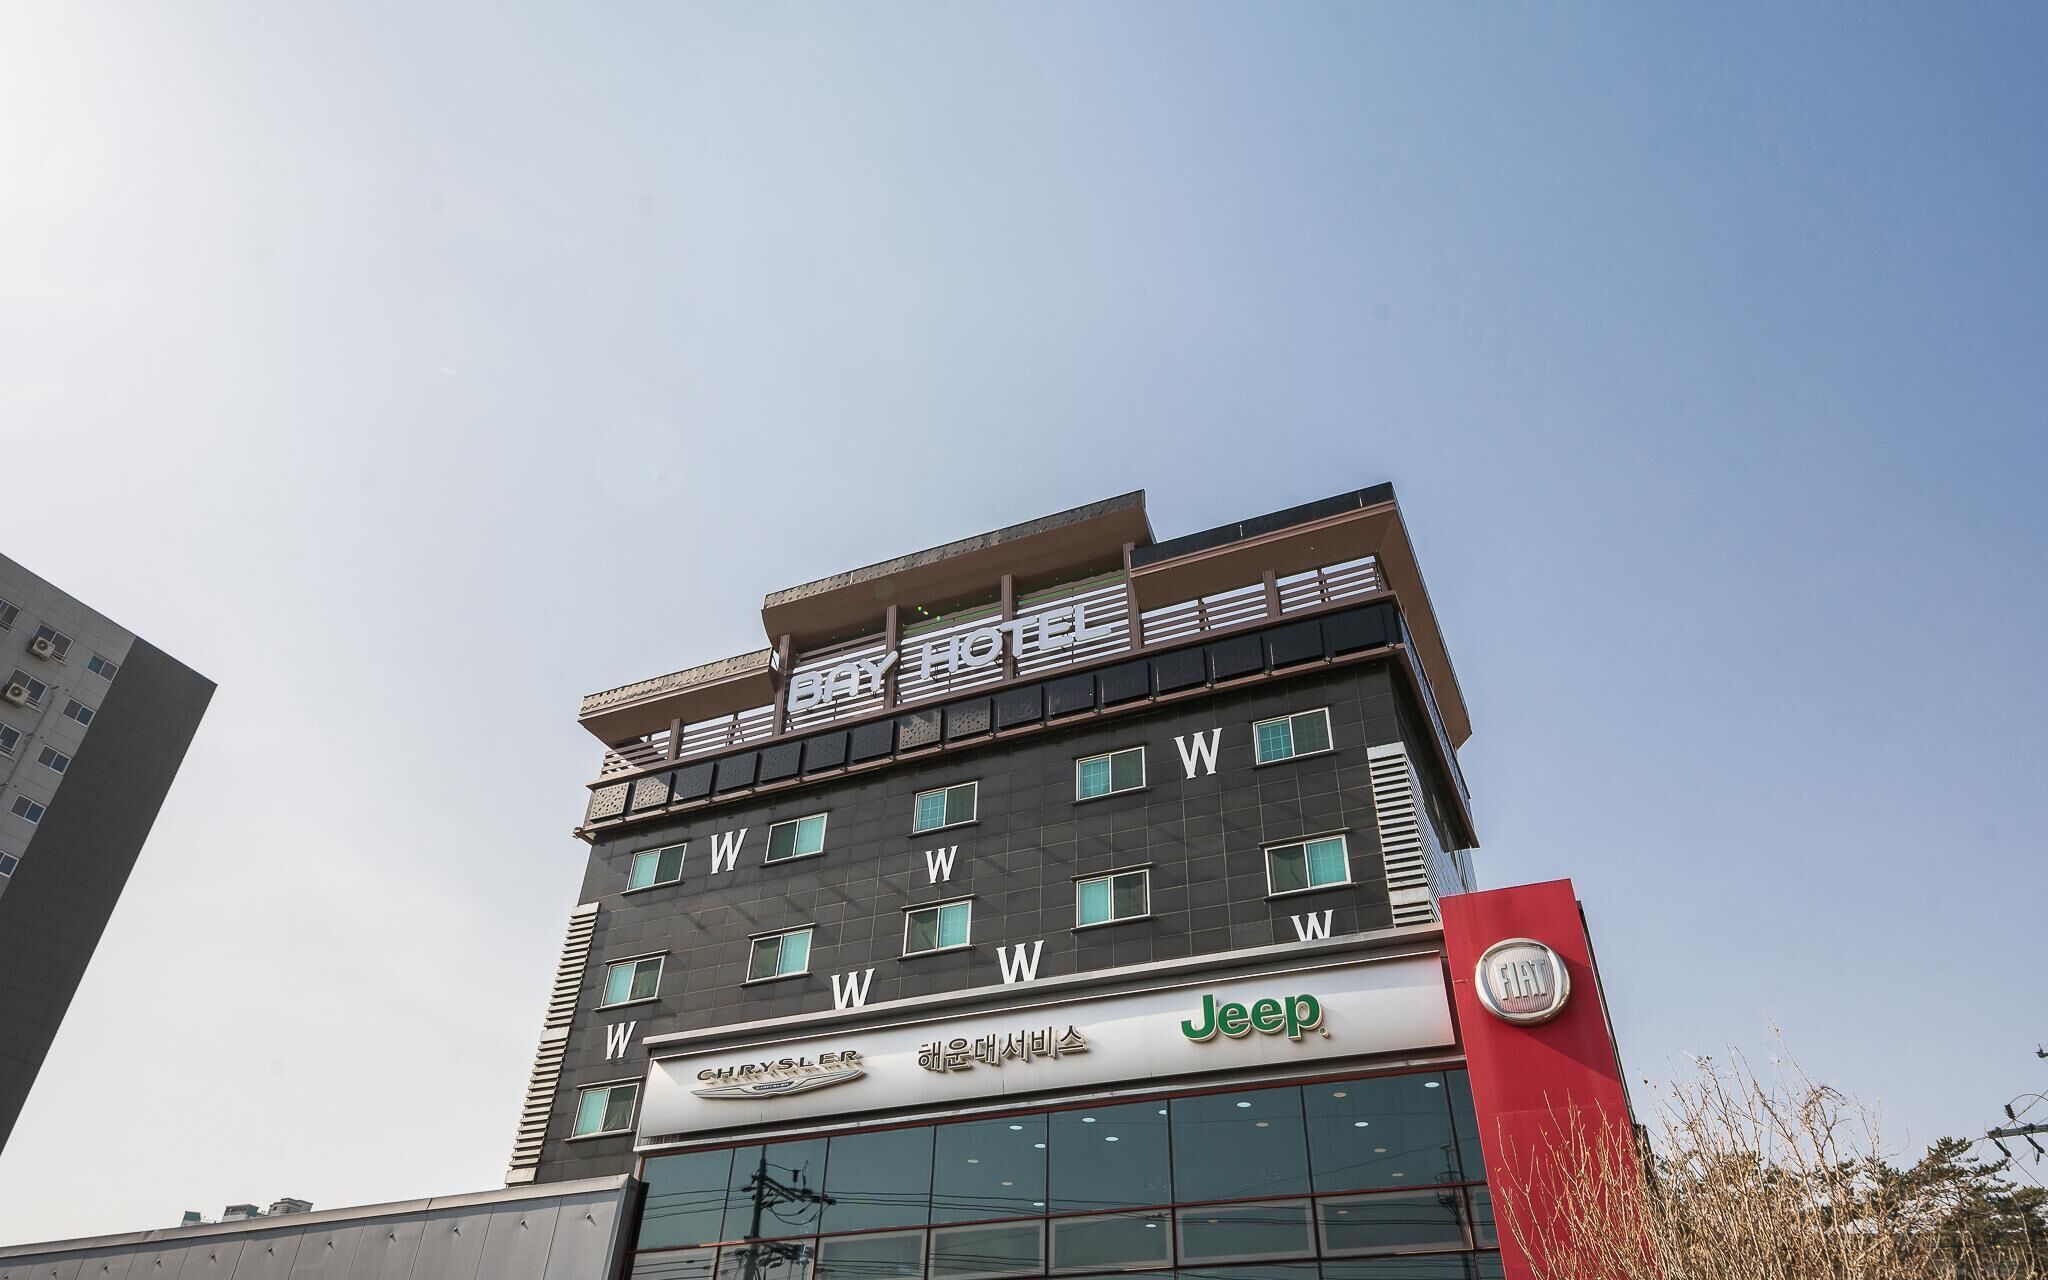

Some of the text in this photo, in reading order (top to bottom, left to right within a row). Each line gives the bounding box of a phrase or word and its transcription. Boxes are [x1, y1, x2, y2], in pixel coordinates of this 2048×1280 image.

[787, 604, 1111, 712] BAY HOTEL
[1174, 728, 1223, 779] W
[710, 828, 748, 875] W
[925, 845, 958, 884] W
[996, 940, 1045, 984] W
[1495, 958, 1548, 1001] FIAT
[830, 968, 875, 1011] W
[605, 1021, 637, 1061] W
[917, 1024, 1088, 1073] 해운대서비스
[696, 1049, 857, 1081] CHRYSLER
